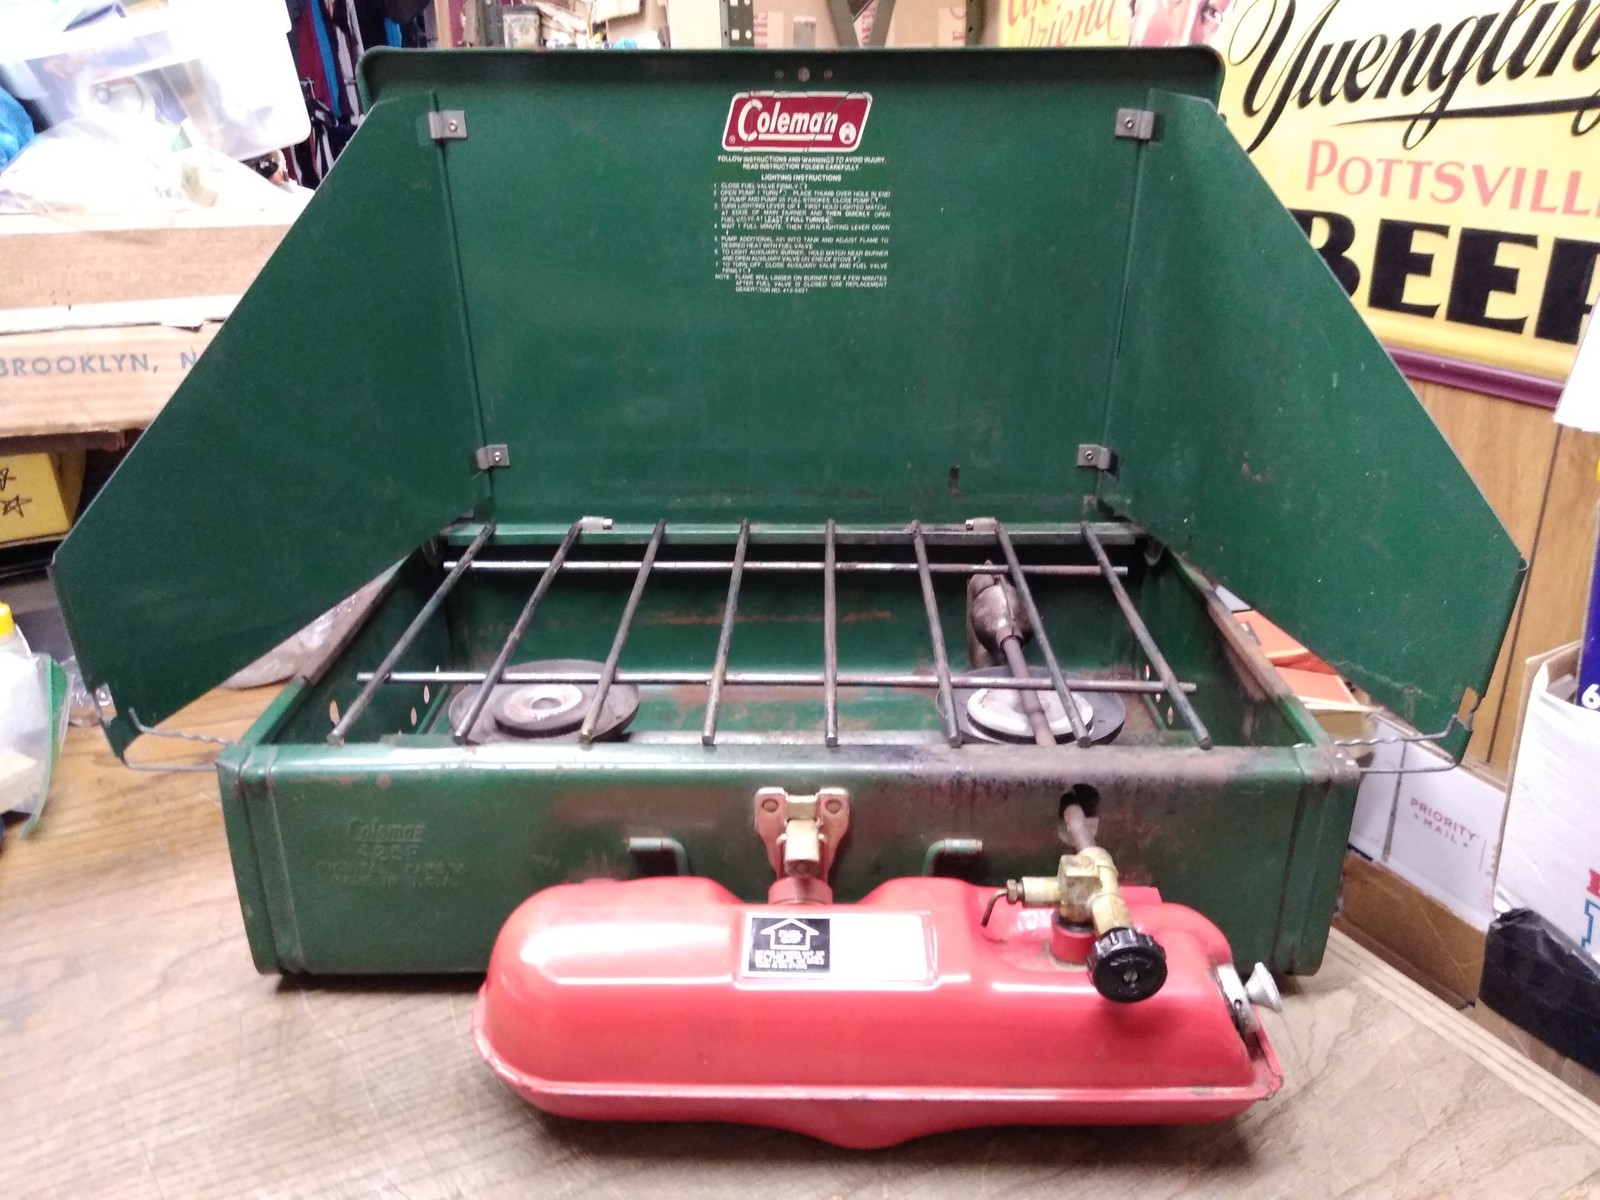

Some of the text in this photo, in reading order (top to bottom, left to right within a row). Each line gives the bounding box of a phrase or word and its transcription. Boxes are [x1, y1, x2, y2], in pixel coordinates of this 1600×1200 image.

[737, 99, 838, 142] Coleman
[760, 163, 800, 171] INSTRUCTION
[801, 163, 824, 171] FOLDER
[788, 155, 800, 163] AND
[1410, 797, 1477, 841] PRIORITY
[1423, 818, 1457, 844] MAIL
